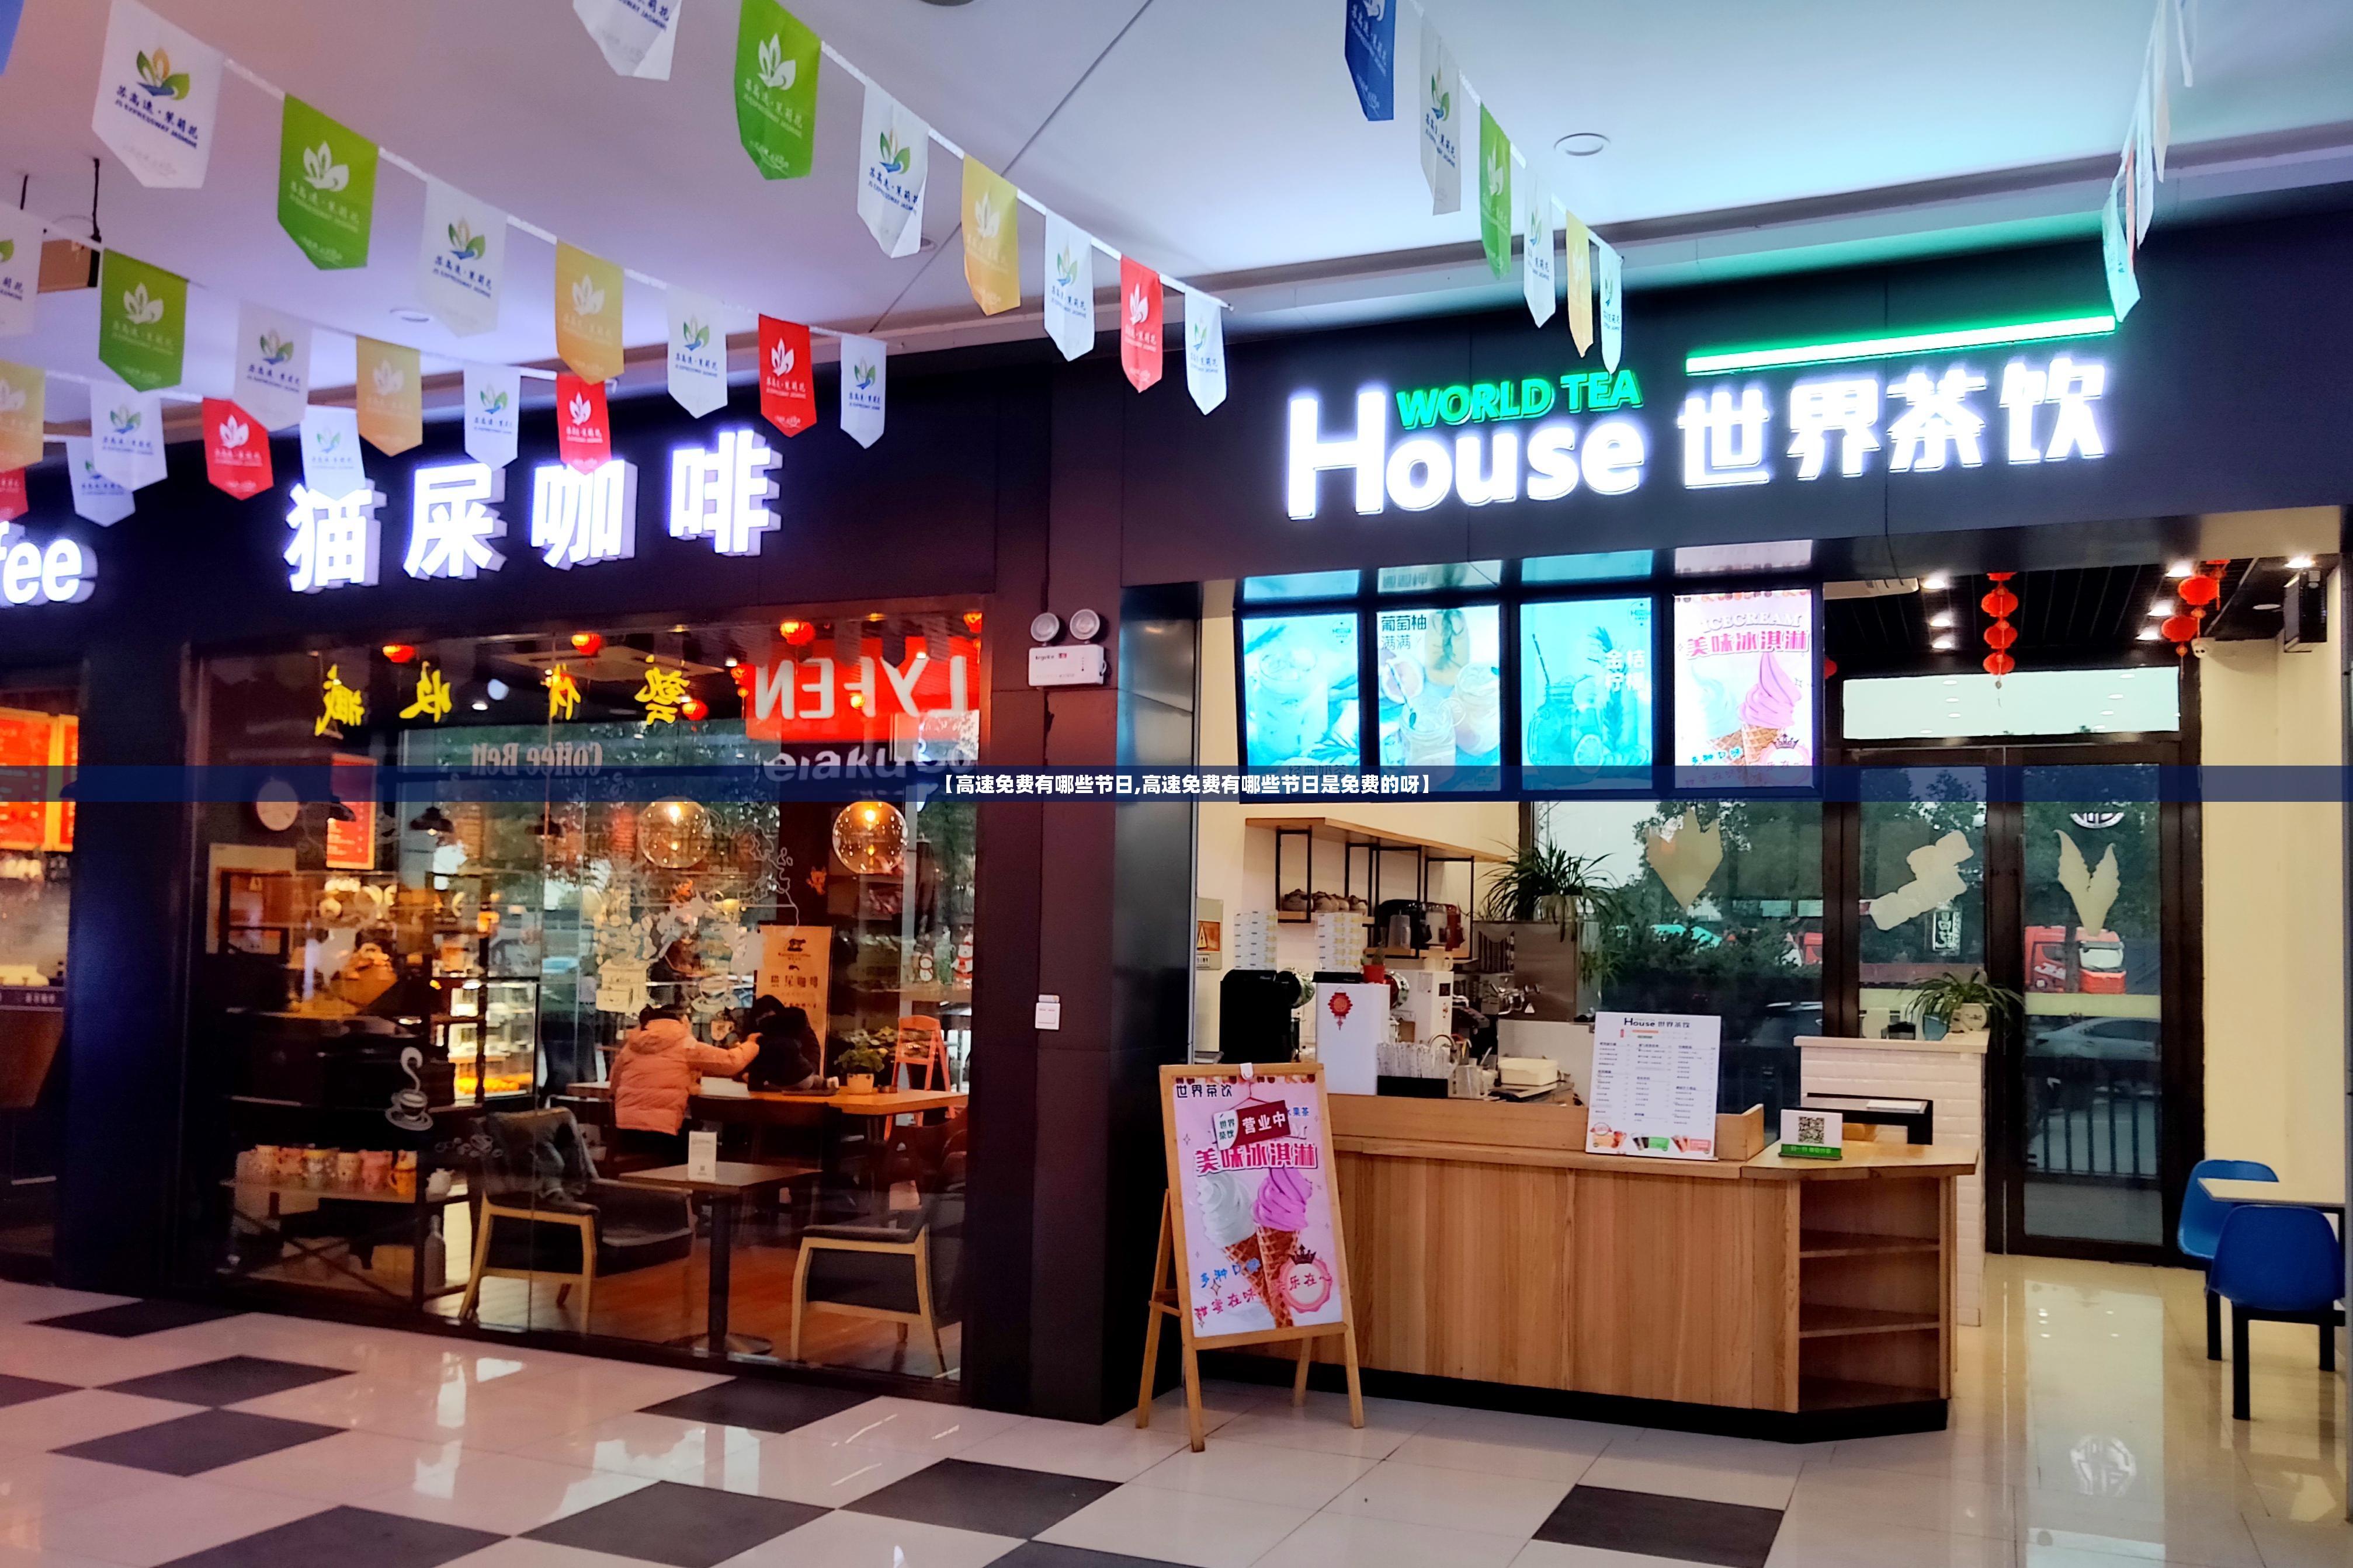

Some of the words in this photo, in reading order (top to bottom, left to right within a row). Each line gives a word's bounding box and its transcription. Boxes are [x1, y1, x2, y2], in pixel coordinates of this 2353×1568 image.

[1396, 380, 1554, 429] WORLD
[1560, 370, 1643, 412] TEA
[1678, 357, 2105, 489] 世界茶饮
[1288, 391, 1644, 520] House
[285, 431, 777, 592] 猫屎咖啡
[1381, 614, 1427, 631] 葡萄柚
[1686, 630, 1807, 658] 美味冰淇淋
[1624, 1017, 1655, 1027] House
[1176, 1084, 1233, 1098] 世界茶饮
[1219, 1118, 1235, 1128] 世界
[1242, 1111, 1286, 1135] 营业中
[1195, 1143, 1316, 1174] 美味冰淇淋
